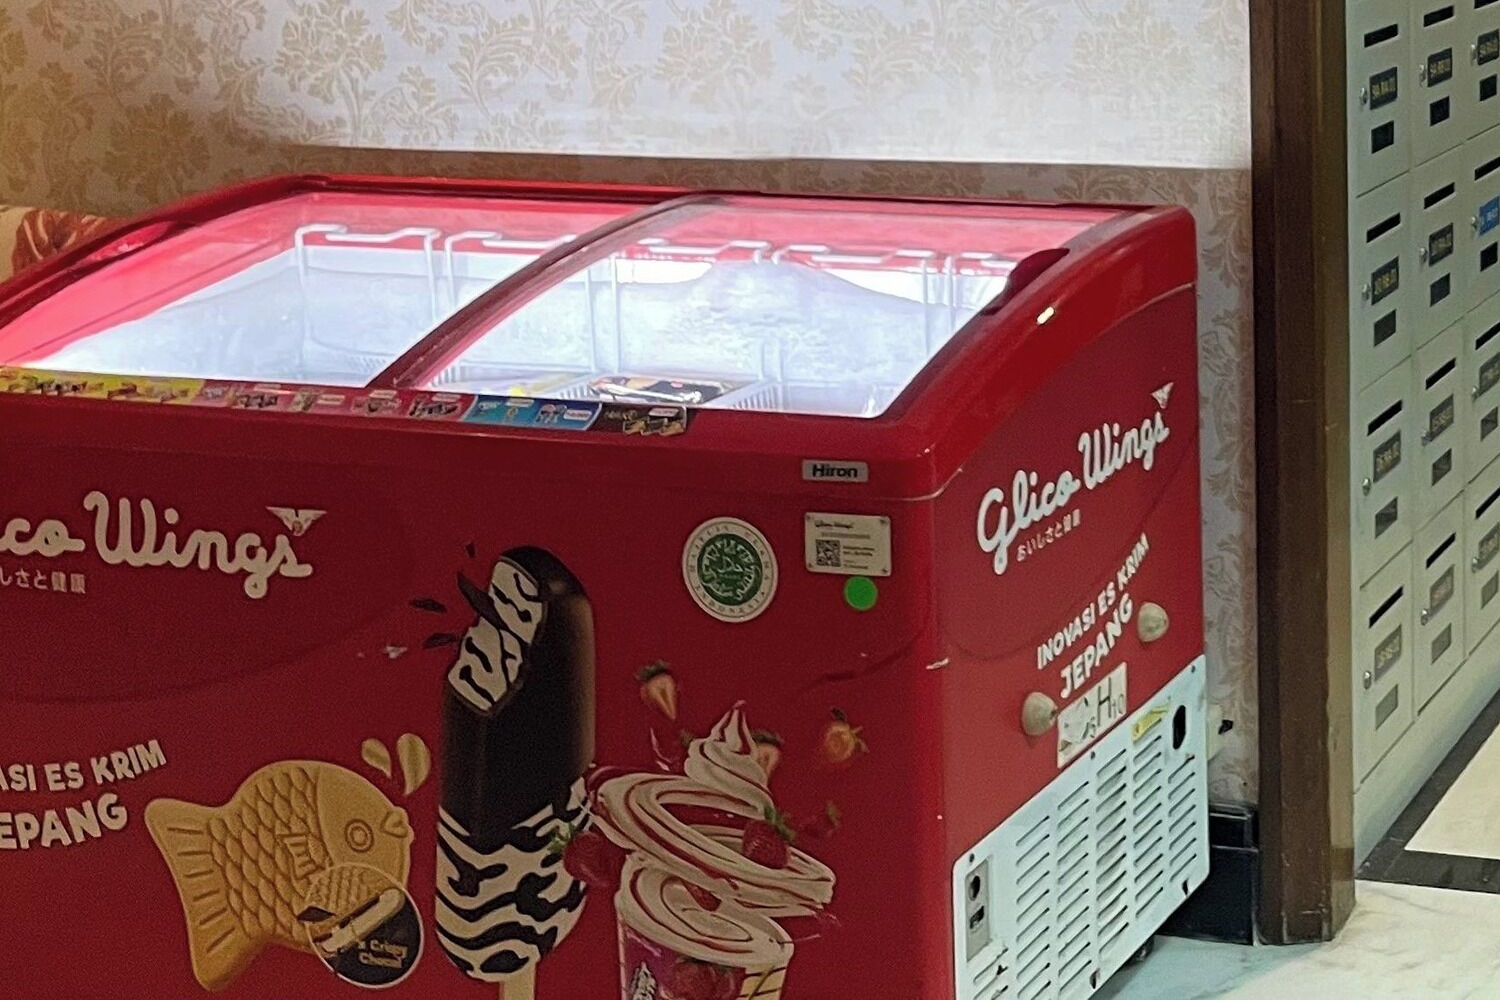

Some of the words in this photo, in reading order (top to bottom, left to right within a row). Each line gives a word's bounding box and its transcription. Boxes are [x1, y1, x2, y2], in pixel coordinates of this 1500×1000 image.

[812, 463, 858, 478] Hiron
[977, 470, 1081, 575] Glico
[1078, 411, 1170, 490] Wings
[0, 518, 85, 557] co
[83, 491, 313, 599] Wings
[1037, 602, 1095, 670] INOVASI
[1098, 581, 1117, 615] ES
[1116, 532, 1149, 591] KRIM
[1060, 593, 1133, 699] JEPANG
[0, 763, 37, 792] SI
[44, 761, 84, 791] ES
[90, 739, 167, 785] KRIM
